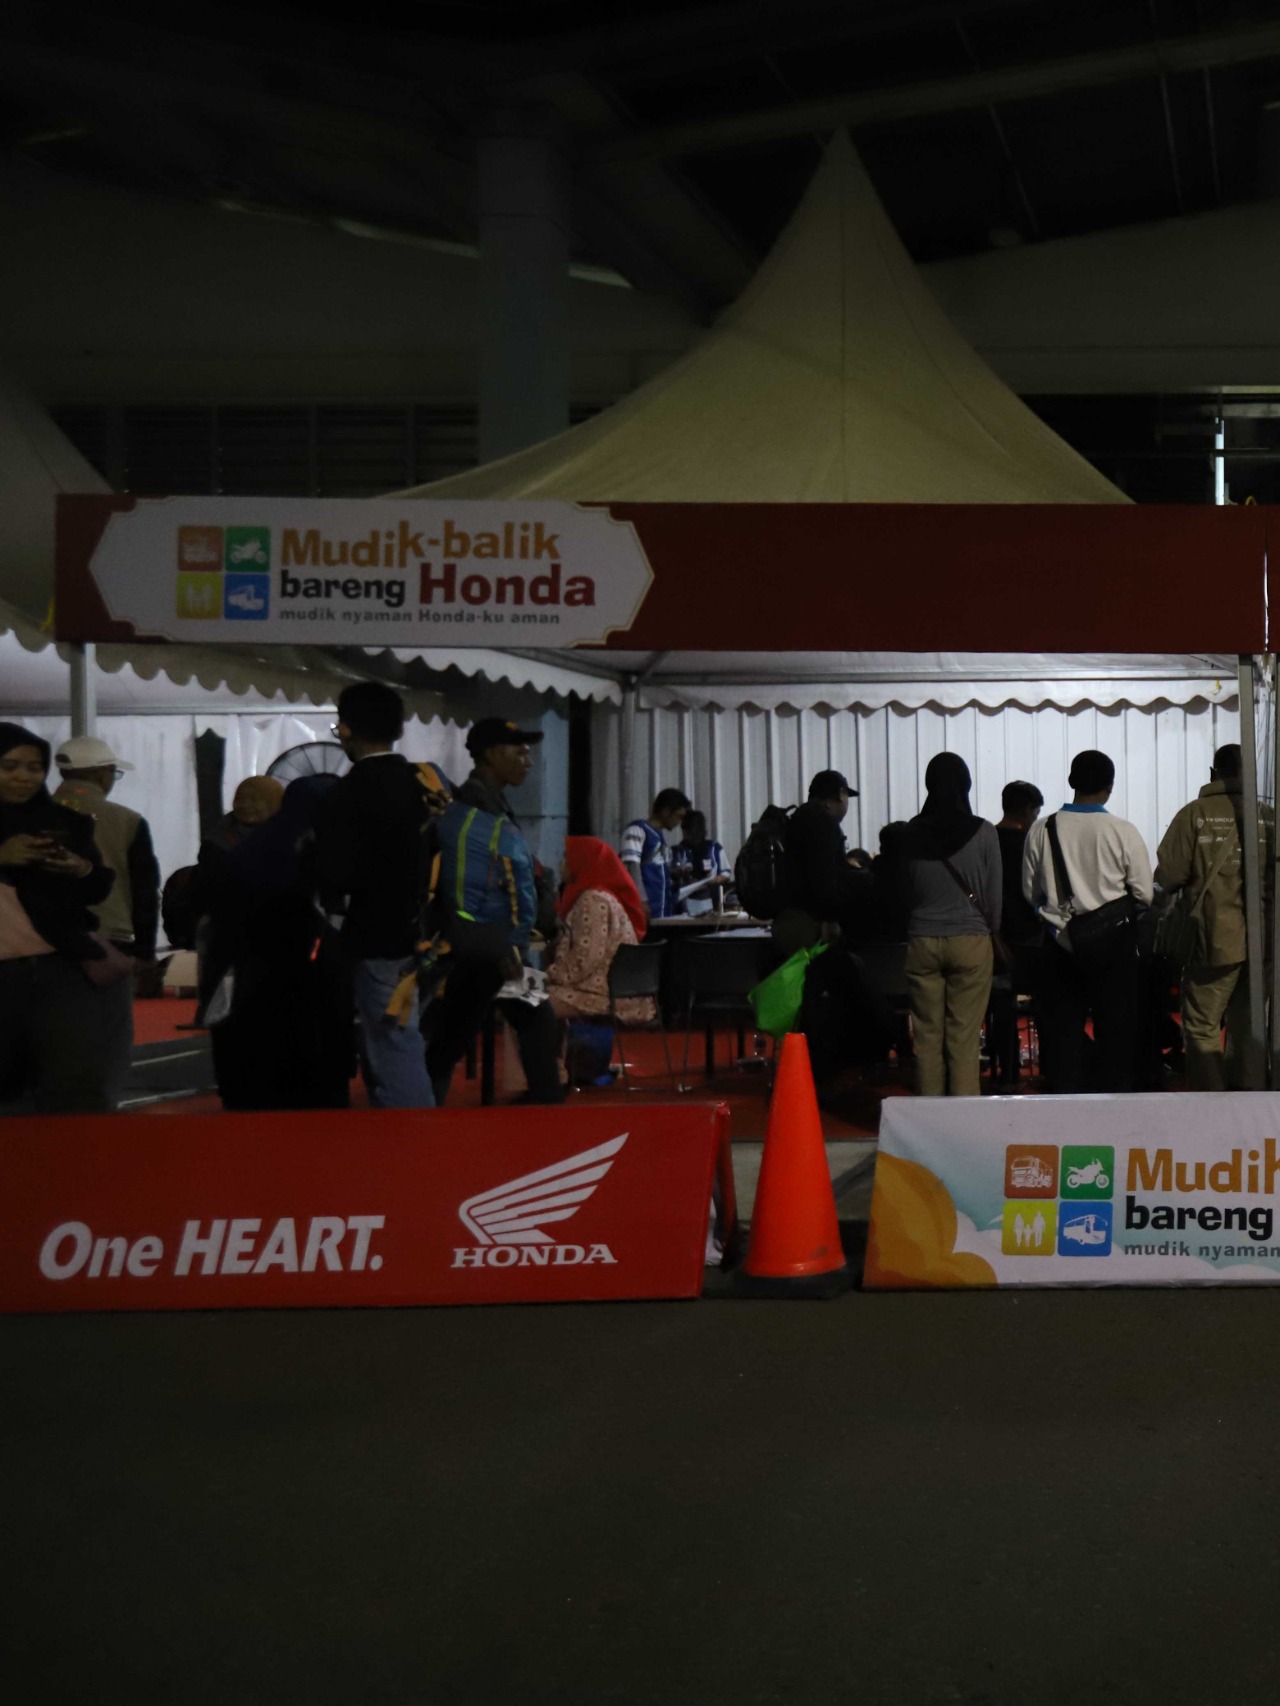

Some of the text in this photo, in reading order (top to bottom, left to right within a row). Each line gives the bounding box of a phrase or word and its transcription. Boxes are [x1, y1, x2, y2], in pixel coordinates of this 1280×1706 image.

[280, 519, 561, 568] Mudik-balik
[280, 562, 596, 608] bareng Honda
[279, 607, 560, 624] mudik nyaman Honda-ku aman
[1125, 1195, 1273, 1241] bareng
[38, 1215, 386, 1281] One HEART.
[450, 1242, 618, 1269] HONDA
[1124, 1241, 1191, 1256] mudik
[1199, 1243, 1280, 1260] nyaman
